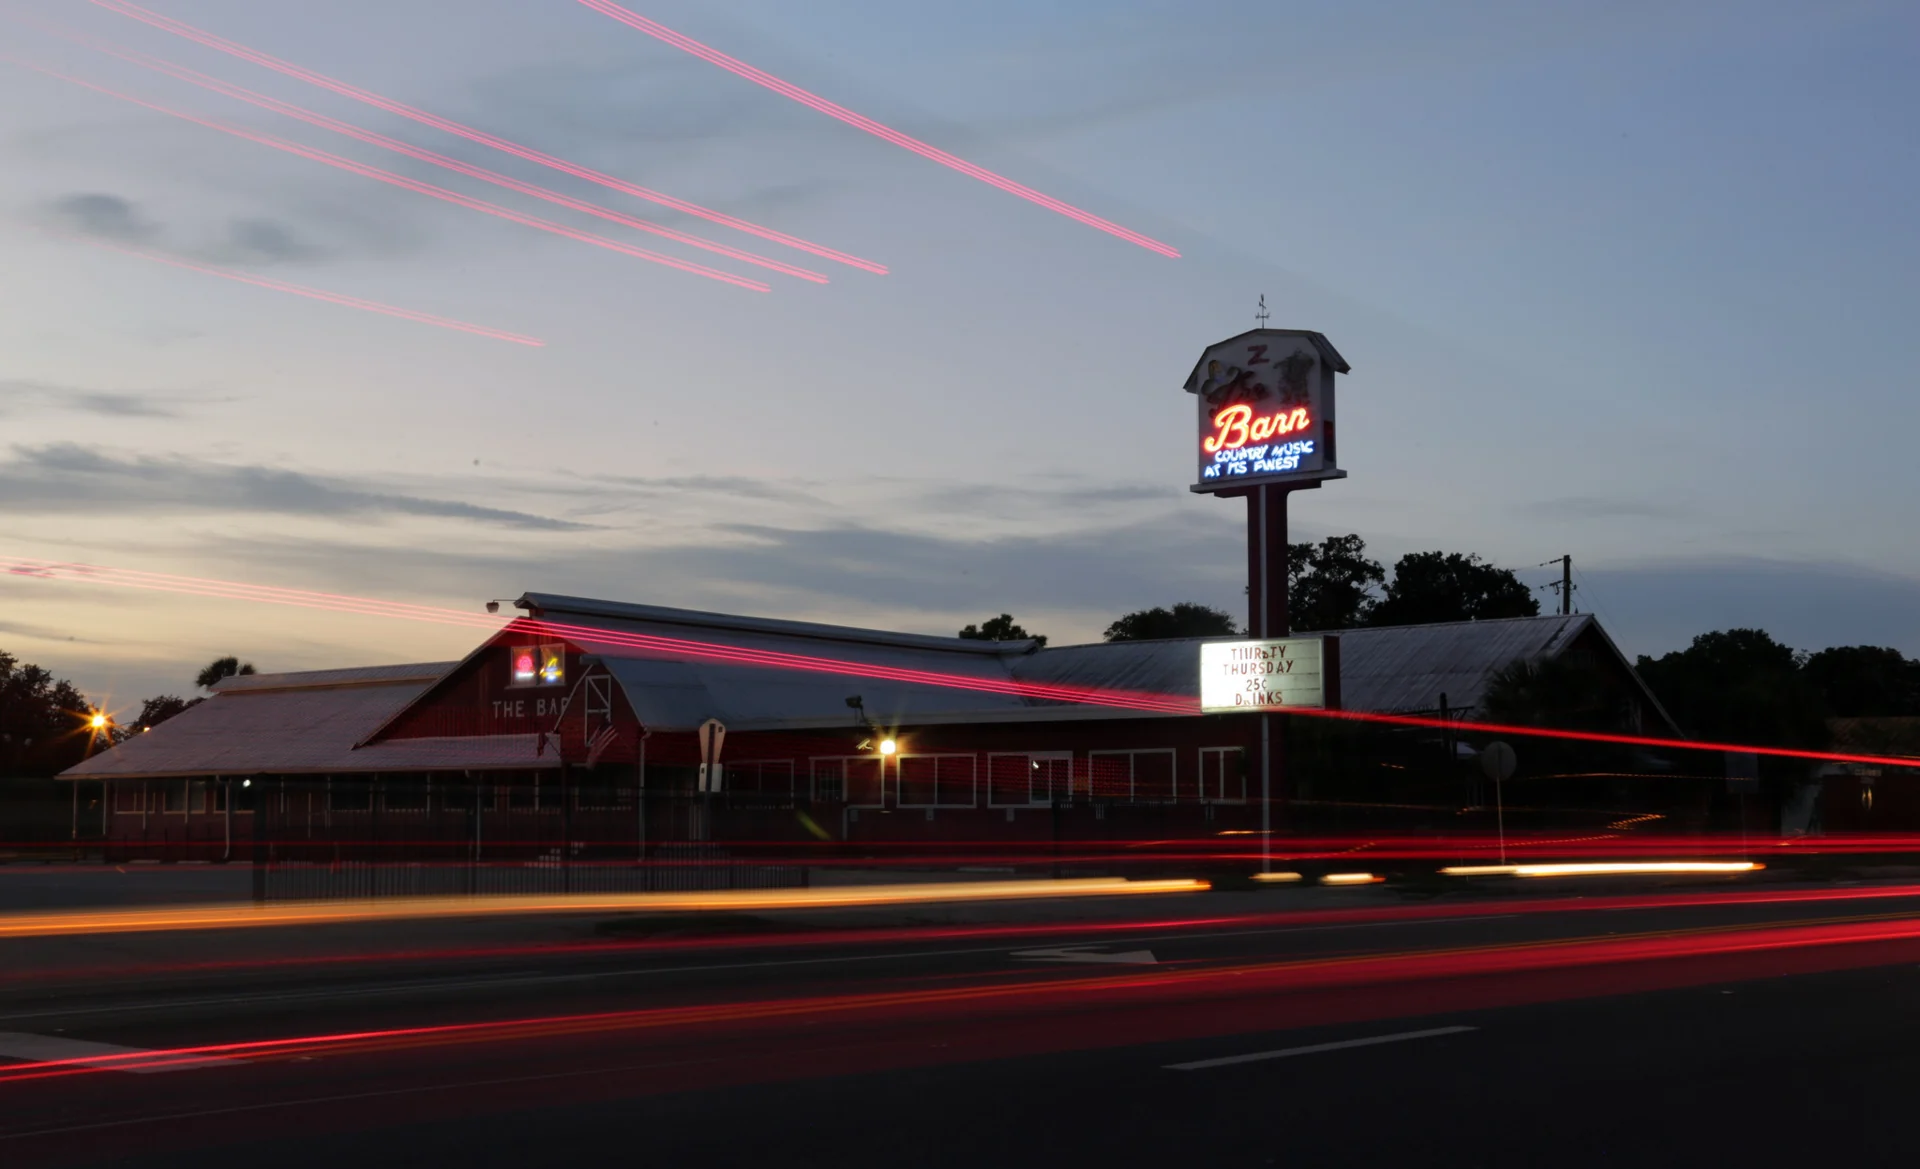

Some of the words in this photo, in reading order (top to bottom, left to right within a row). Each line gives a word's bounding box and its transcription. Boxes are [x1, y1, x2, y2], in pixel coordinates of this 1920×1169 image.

[1247, 344, 1270, 366] Z
[1204, 404, 1310, 452] Barn
[1214, 444, 1269, 463] COUNTRY
[1271, 440, 1314, 457] MUSIC
[1204, 463, 1221, 477] AT
[1253, 455, 1300, 472] FINEST
[1223, 660, 1294, 675] THURSDAY
[492, 700, 525, 719] THE
